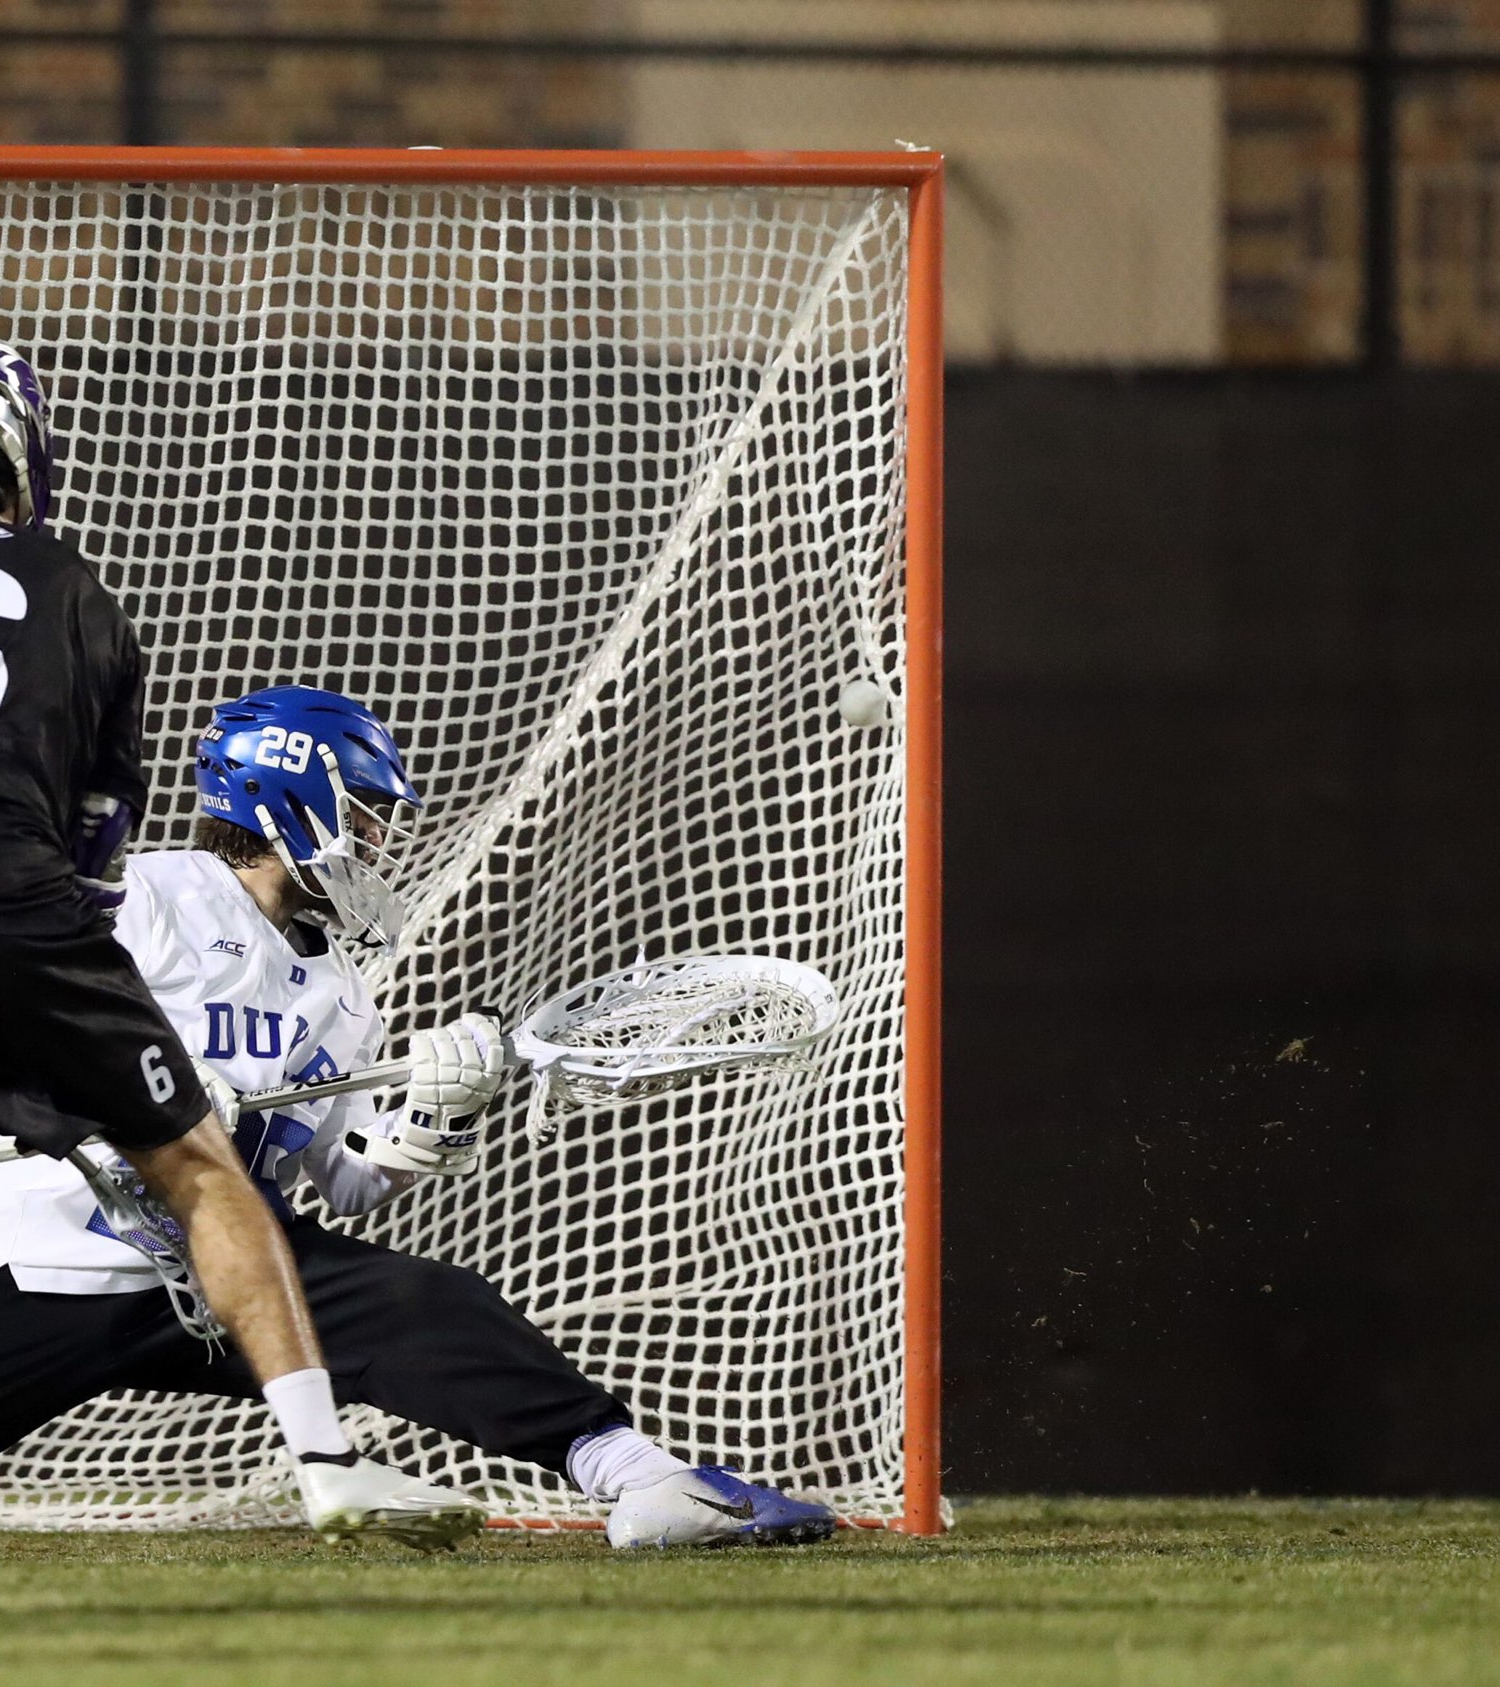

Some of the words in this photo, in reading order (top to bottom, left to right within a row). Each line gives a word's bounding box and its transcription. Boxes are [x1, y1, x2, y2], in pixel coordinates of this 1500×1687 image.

[255, 726, 314, 775] 29
[342, 811, 353, 832] STX
[210, 939, 247, 956] ACC
[289, 964, 307, 986] D
[138, 1044, 176, 1104] 6
[433, 1130, 480, 1148] STX
